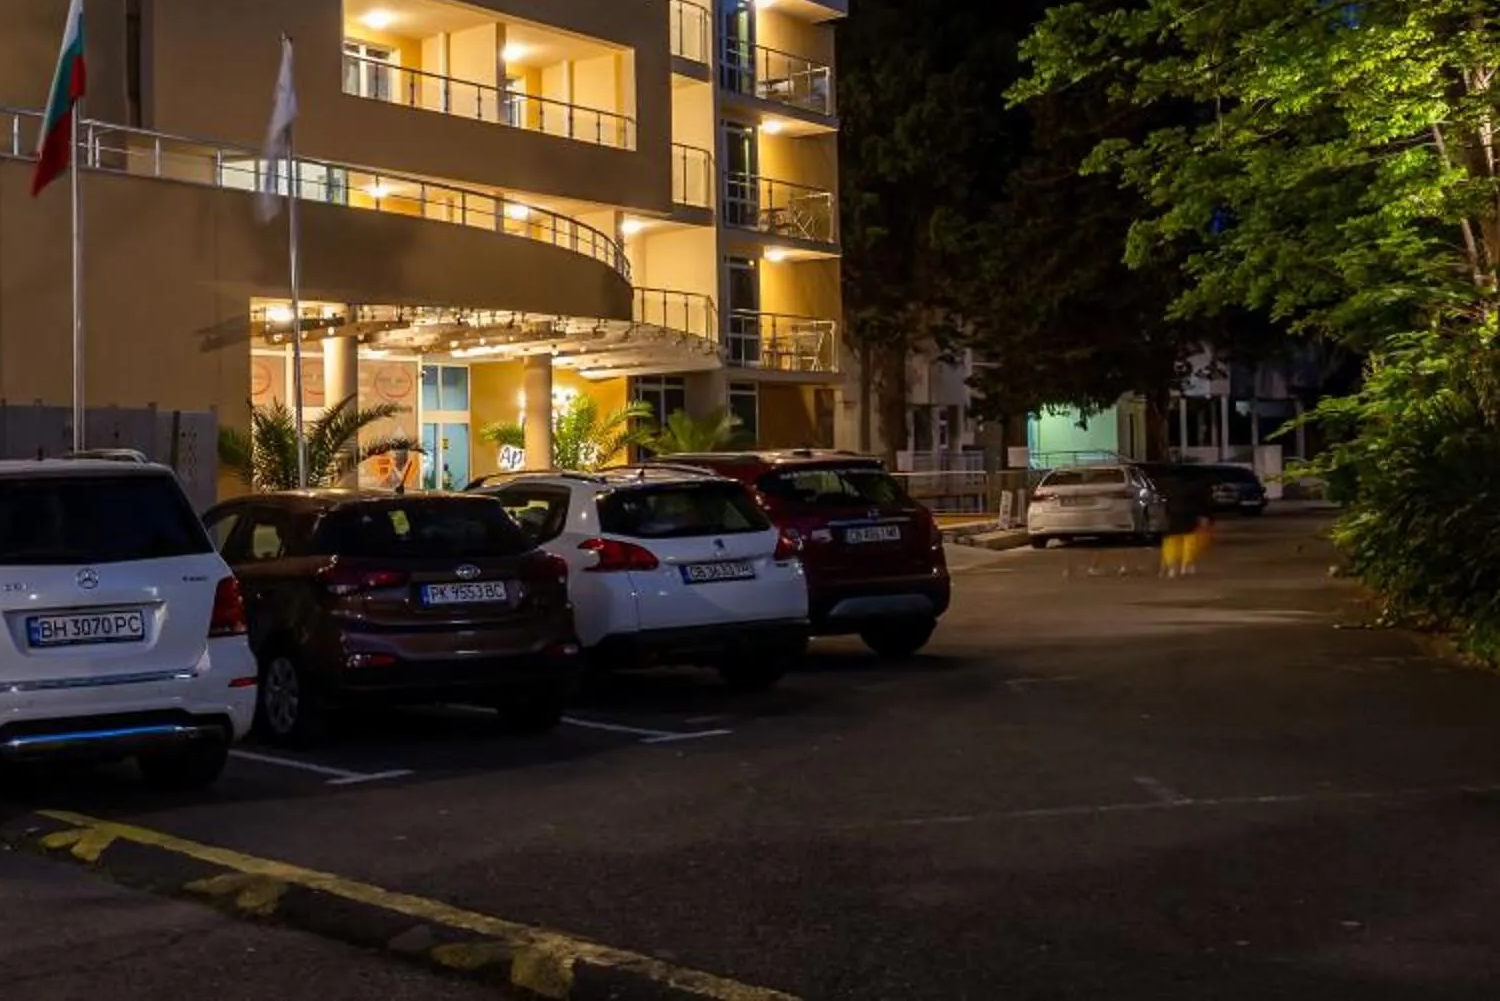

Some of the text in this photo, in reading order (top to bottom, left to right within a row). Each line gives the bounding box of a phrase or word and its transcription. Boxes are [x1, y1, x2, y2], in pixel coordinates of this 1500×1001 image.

[40, 614, 141, 639] BH 3070 PC
